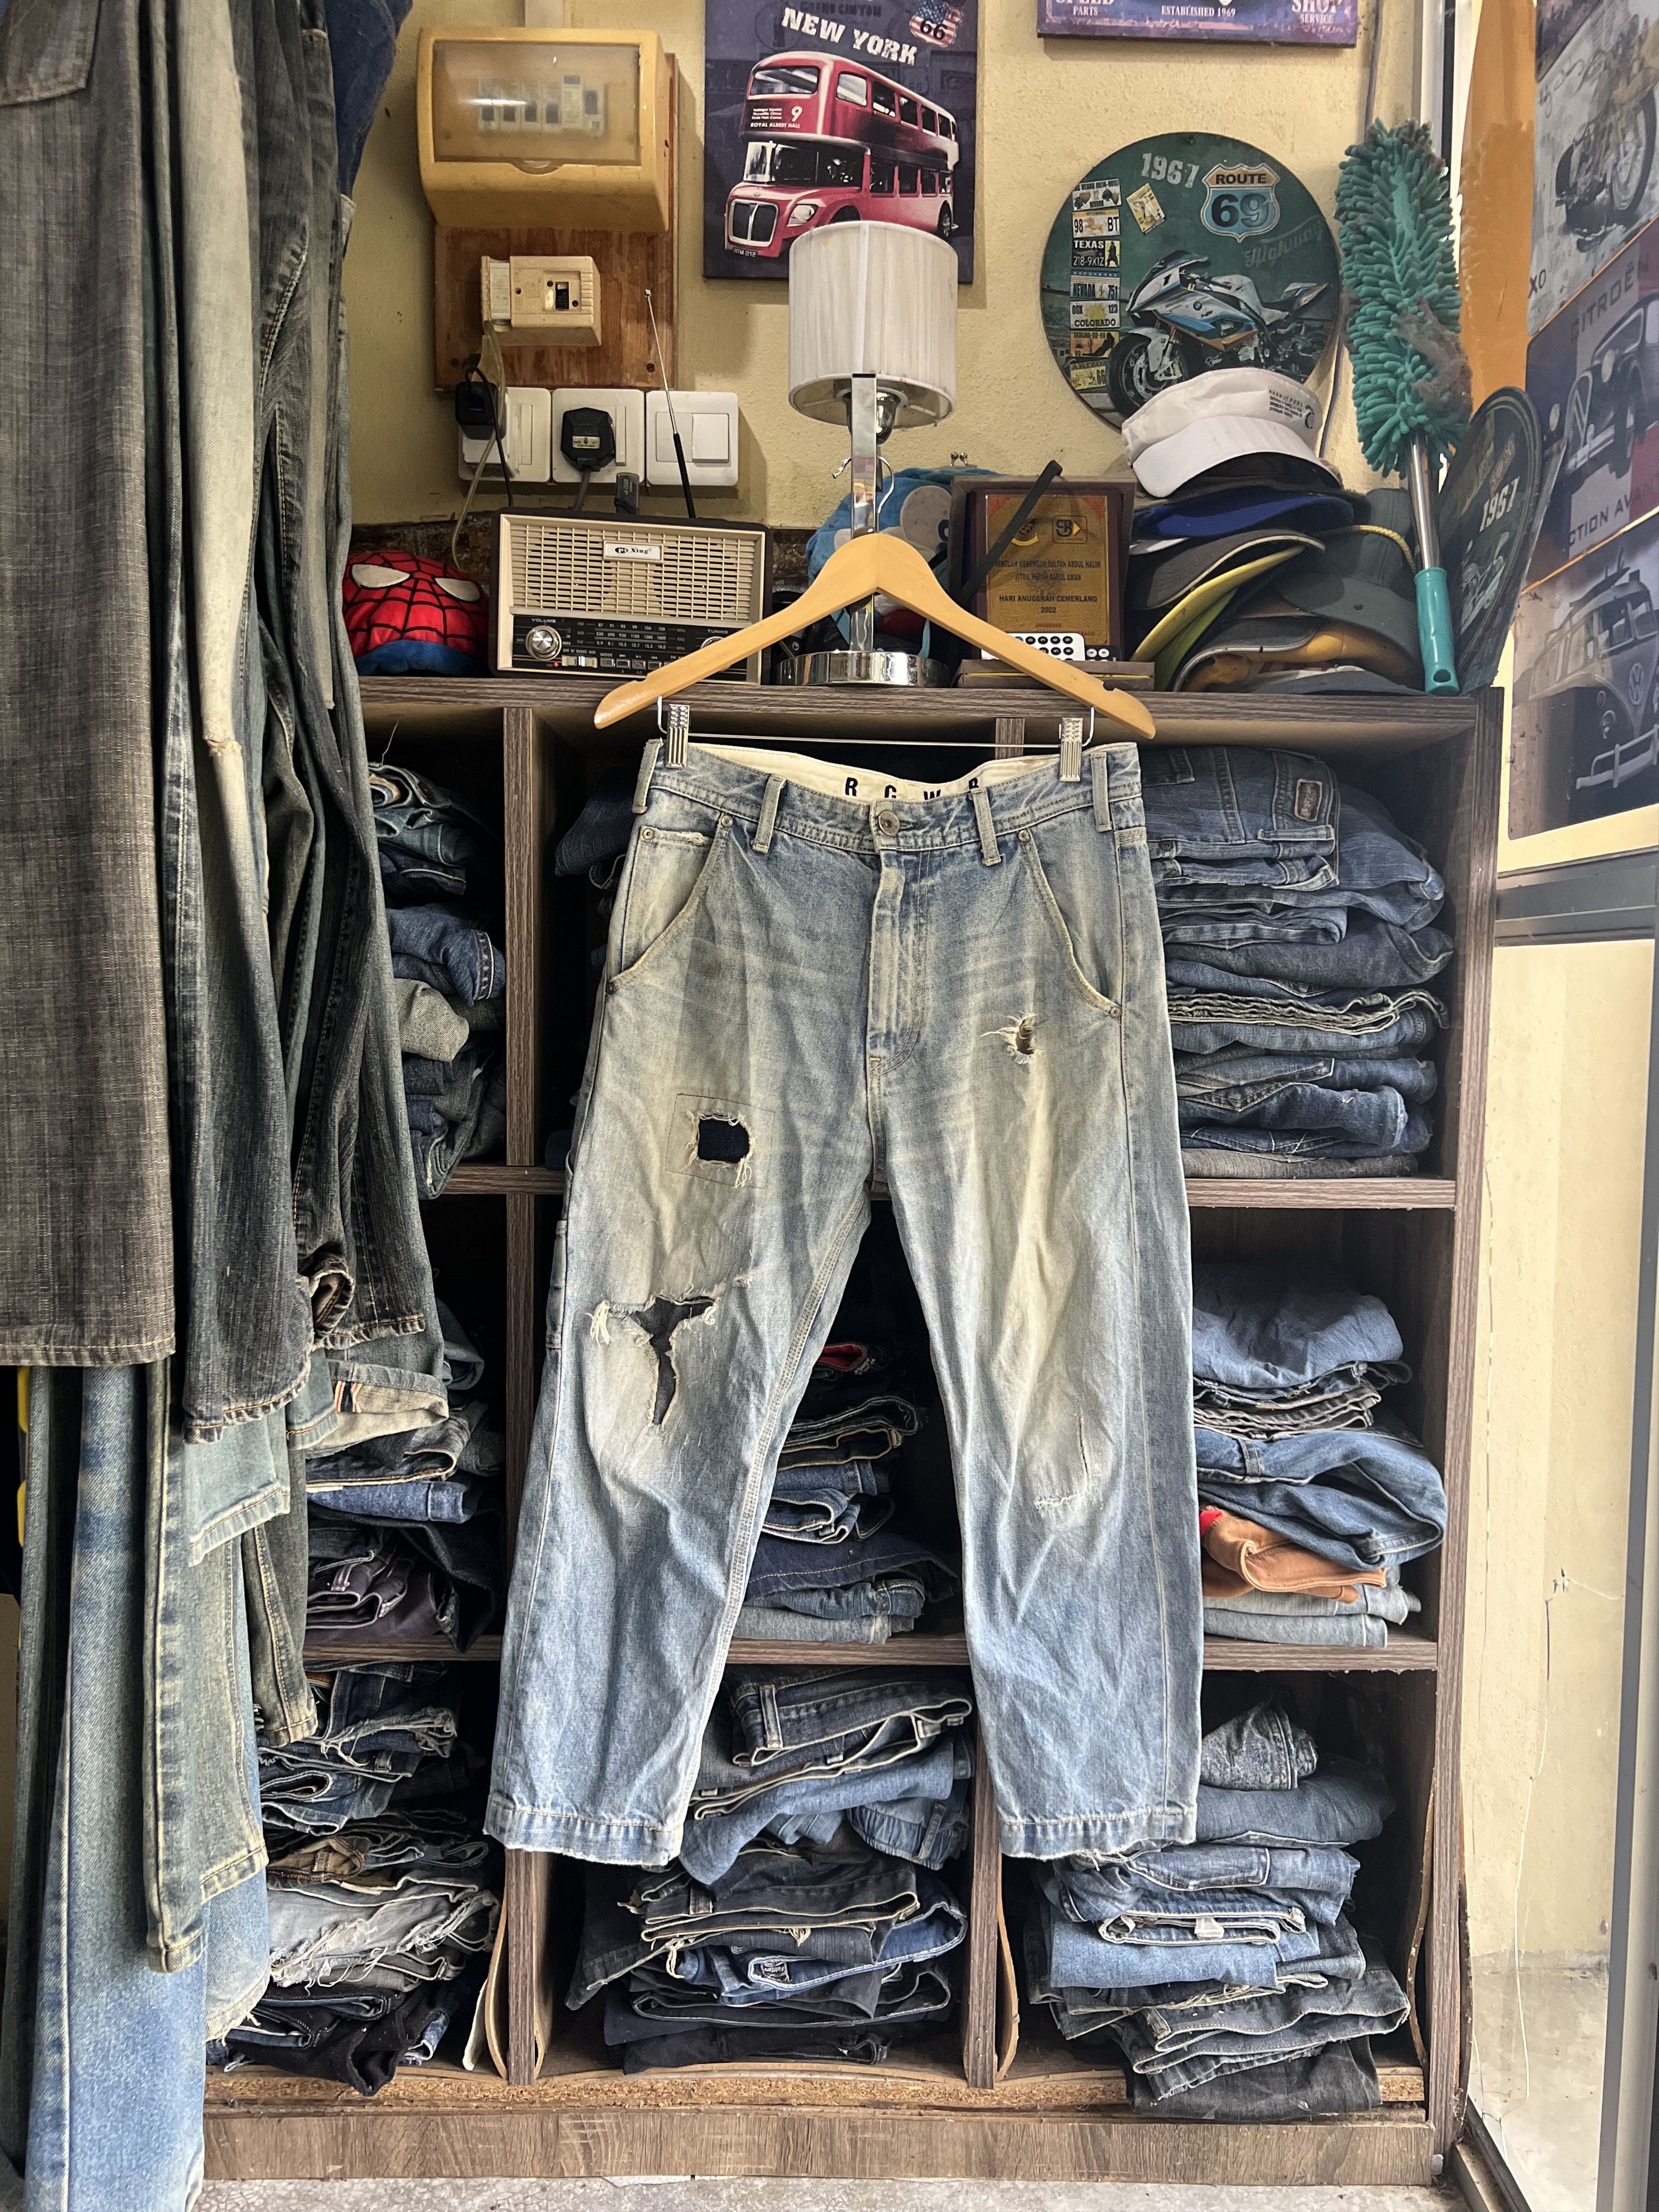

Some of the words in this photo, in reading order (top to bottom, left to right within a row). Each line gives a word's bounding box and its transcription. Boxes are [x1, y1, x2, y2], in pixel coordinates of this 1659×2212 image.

[1073, 6, 1098, 16] PARTS
[1162, 5, 1214, 17] ESTABLISHED
[1217, 8, 1236, 17] 1969
[1300, 13, 1334, 24] SERVICE
[781, 7, 846, 43] NEW
[853, 28, 918, 66] YORK
[920, 18, 946, 41] 66
[791, 106, 802, 122] 9
[1141, 153, 1200, 189] 1967
[1216, 173, 1267, 185] ROUTE
[1211, 193, 1269, 228] 69
[1074, 218, 1084, 233] 98
[1107, 217, 1119, 232] BT
[1074, 240, 1104, 248] TEXAS
[1074, 319, 1116, 327] COLORADO
[845, 777, 858, 797] R
